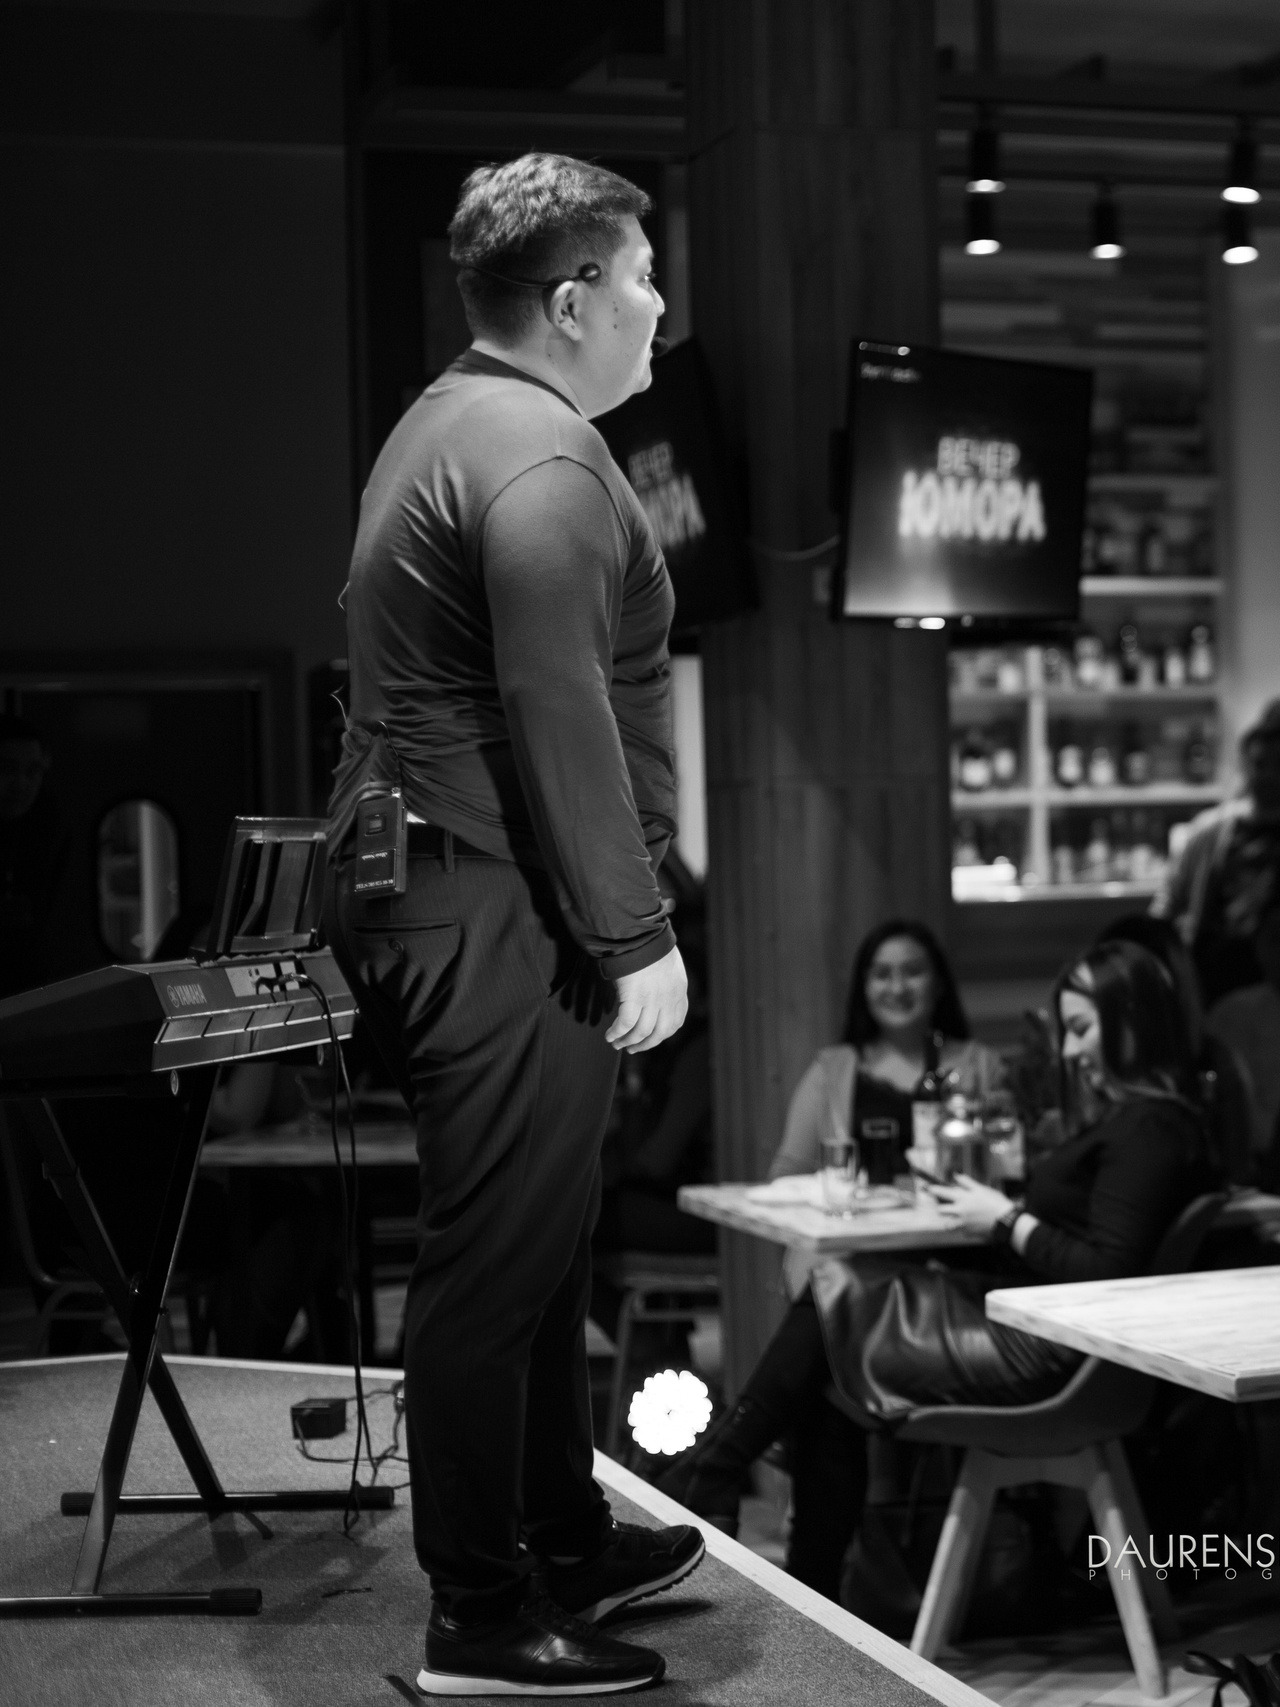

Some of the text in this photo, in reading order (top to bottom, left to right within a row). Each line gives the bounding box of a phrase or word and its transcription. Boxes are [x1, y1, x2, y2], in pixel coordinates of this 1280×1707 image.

[937, 436, 1020, 479] ВЕЧЕР
[900, 470, 1046, 542] ЮМОРА
[173, 984, 208, 1006] YAMAHA
